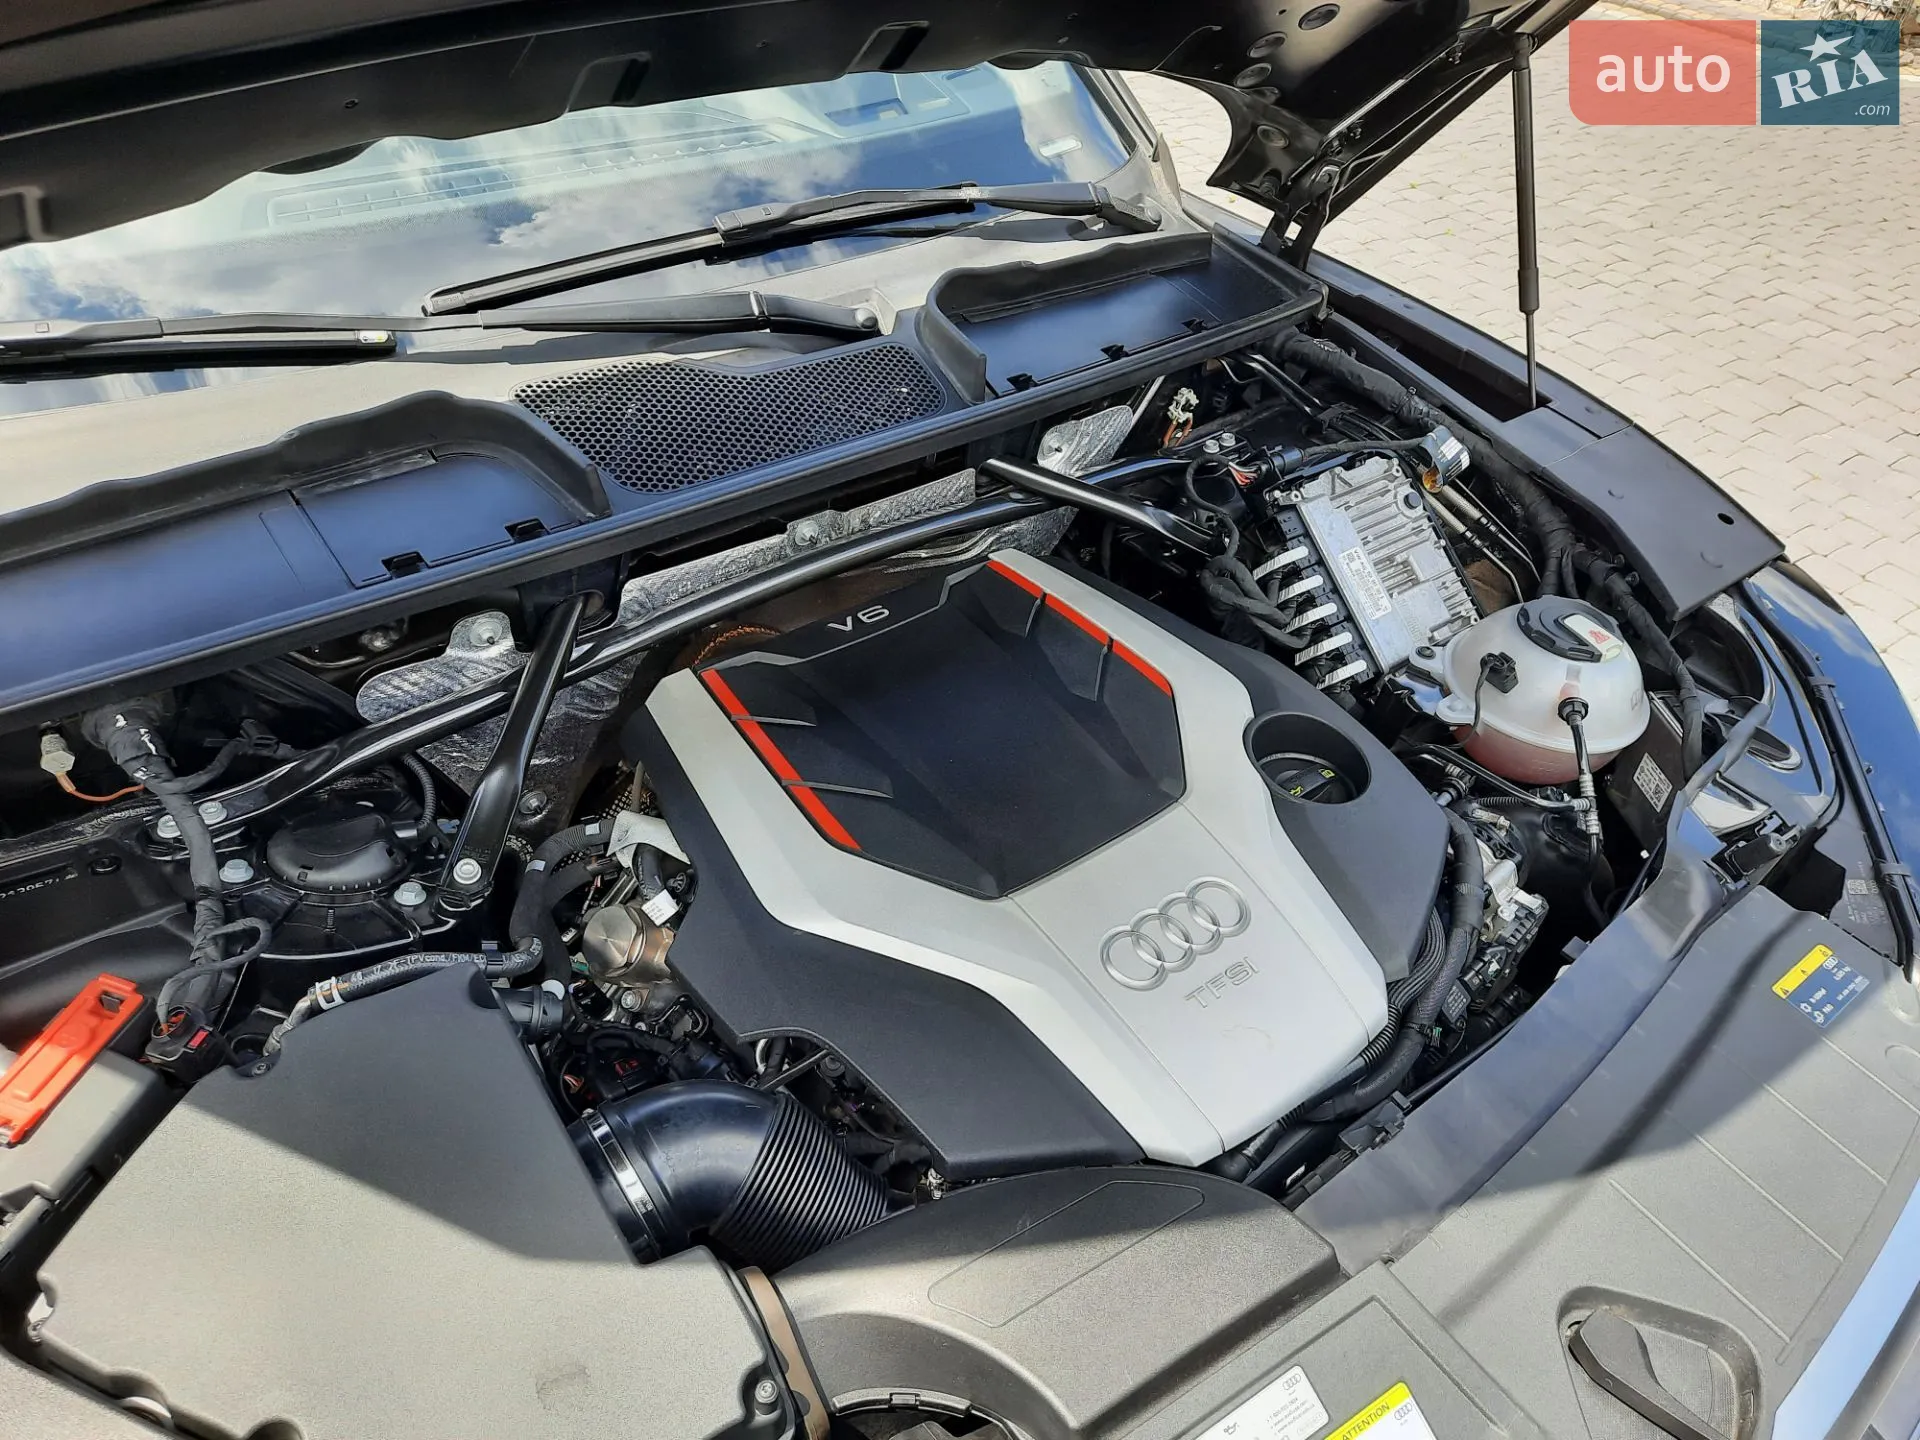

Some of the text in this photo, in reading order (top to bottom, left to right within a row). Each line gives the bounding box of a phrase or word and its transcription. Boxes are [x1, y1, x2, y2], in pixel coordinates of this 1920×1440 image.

[826, 604, 890, 632] V6
[1184, 956, 1260, 1009] TFSI
[1342, 1401, 1390, 1440] ATTENTION
